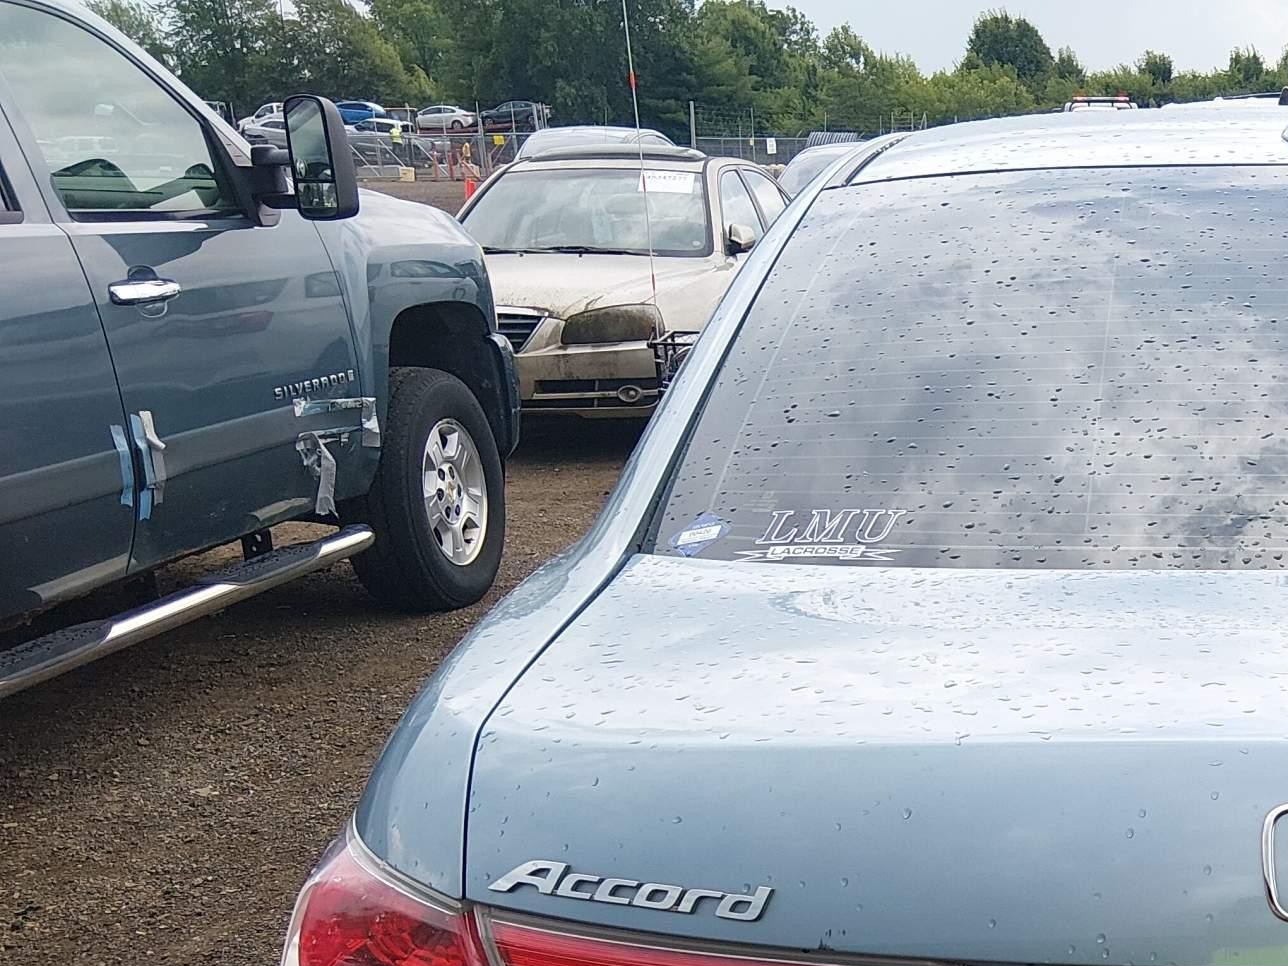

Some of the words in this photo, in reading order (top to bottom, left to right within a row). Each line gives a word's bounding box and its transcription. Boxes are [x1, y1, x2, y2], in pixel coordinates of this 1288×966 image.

[274, 372, 346, 400] SILVERADO
[755, 509, 907, 545] LMU
[770, 546, 861, 556] LACROSSE
[488, 860, 775, 922] Accord
